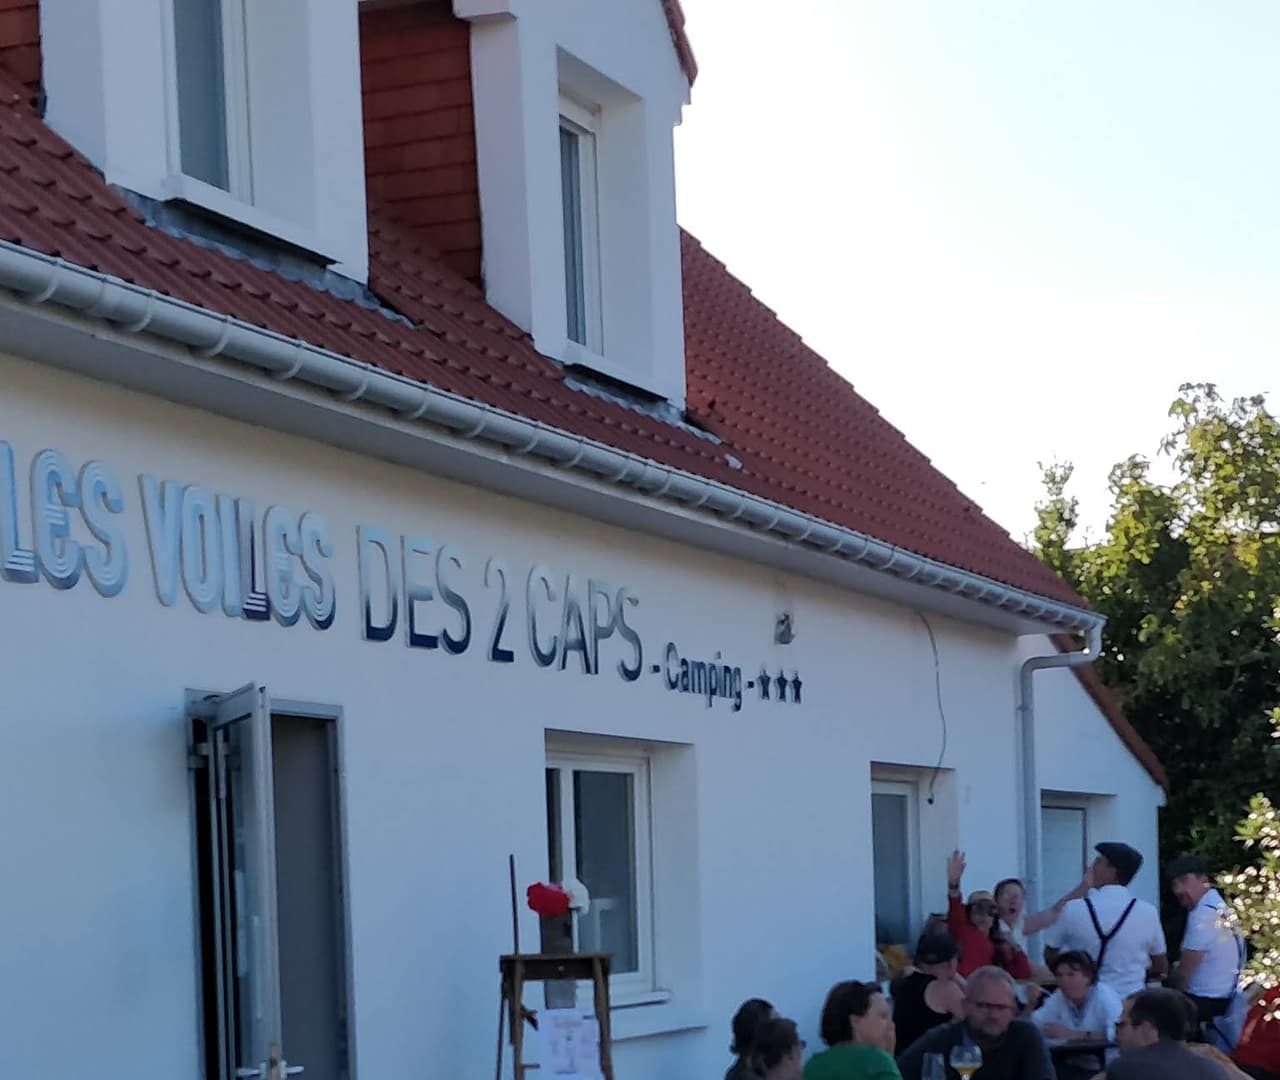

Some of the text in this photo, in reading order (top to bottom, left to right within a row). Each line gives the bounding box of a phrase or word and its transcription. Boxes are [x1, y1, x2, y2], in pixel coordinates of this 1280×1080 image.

[355, 524, 472, 655] DES
[483, 554, 515, 663] 2
[526, 563, 644, 682] CAPS
